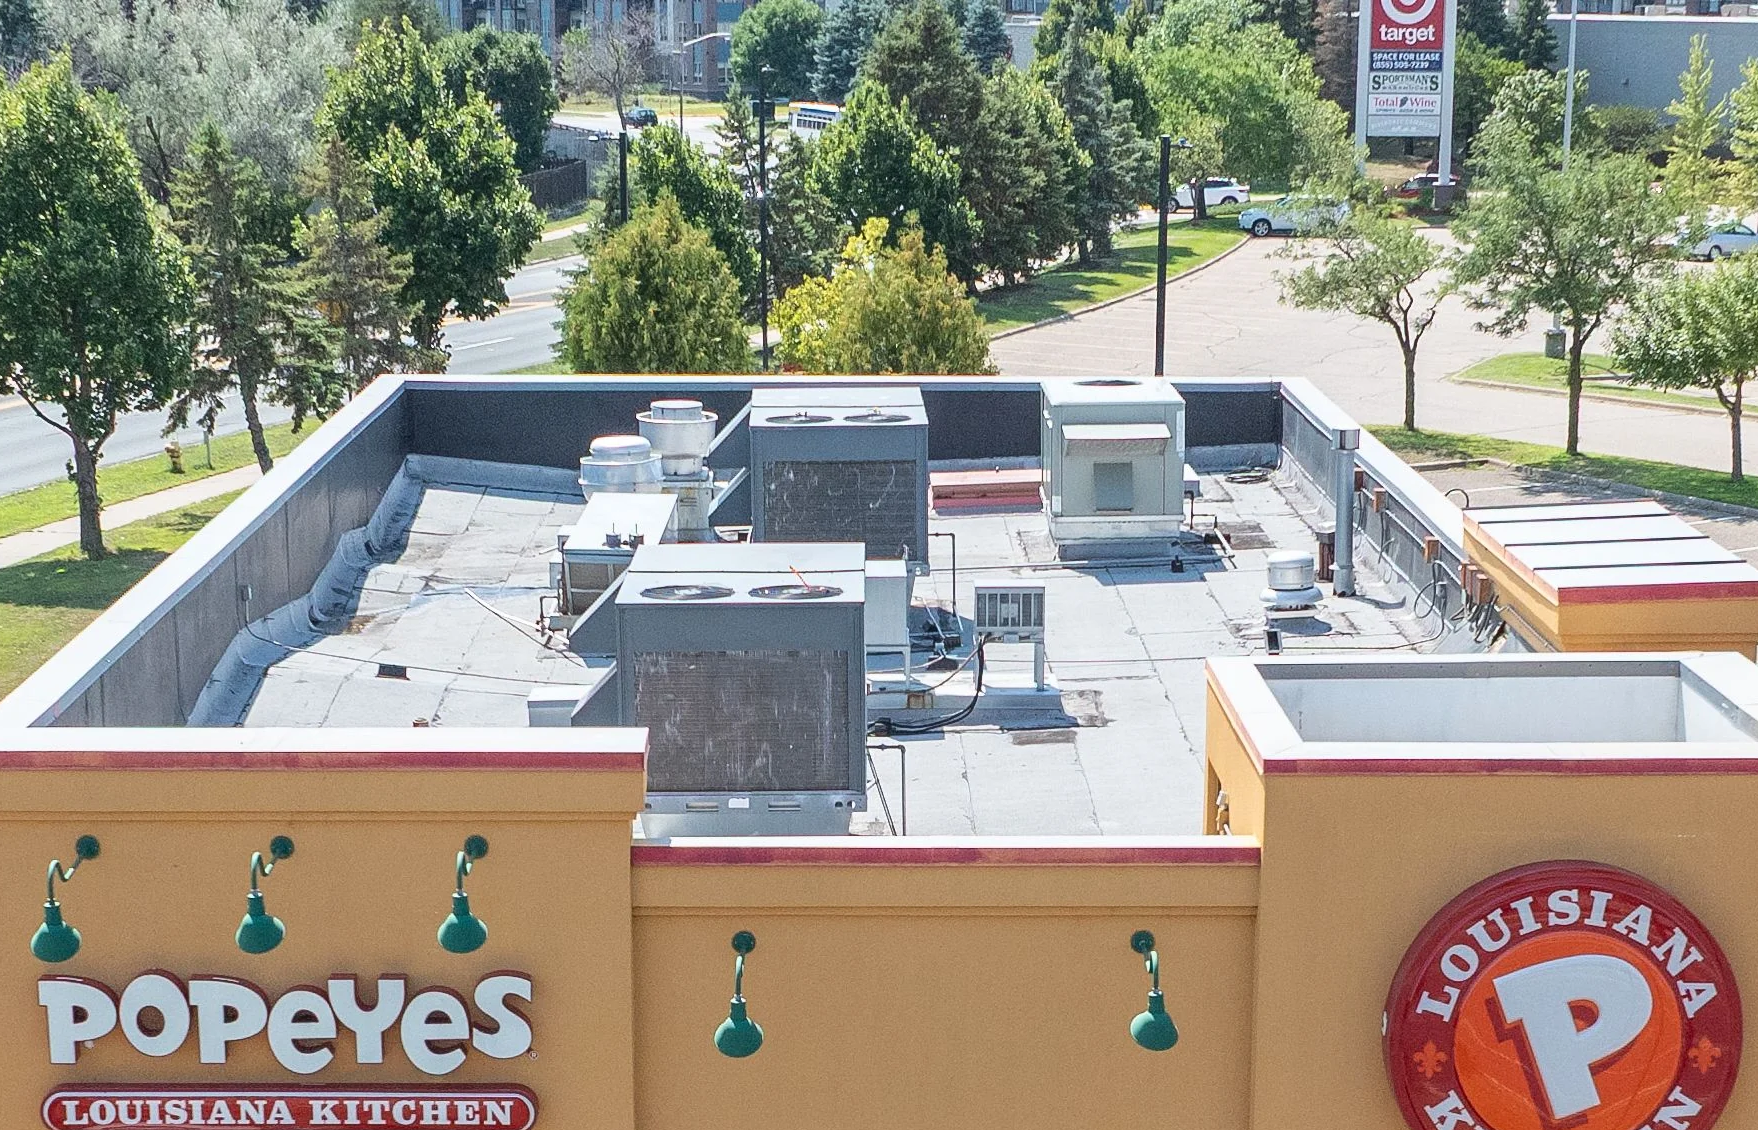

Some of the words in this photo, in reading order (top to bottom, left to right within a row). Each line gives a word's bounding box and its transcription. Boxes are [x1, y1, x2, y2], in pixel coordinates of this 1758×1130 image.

[1378, 23, 1435, 45] target
[1372, 52, 1398, 61] SPACE
[1398, 52, 1415, 61] FOR
[1415, 52, 1440, 61] LEASE
[1371, 74, 1439, 91] SPORTSMAN'S
[1374, 96, 1398, 108] Total
[1410, 96, 1437, 108] Wine
[1416, 888, 1718, 1024] LOUISIANA
[1492, 953, 1654, 1121] P
[61, 1099, 296, 1126] LOUISIANA
[308, 1099, 515, 1126] KITCHEN
